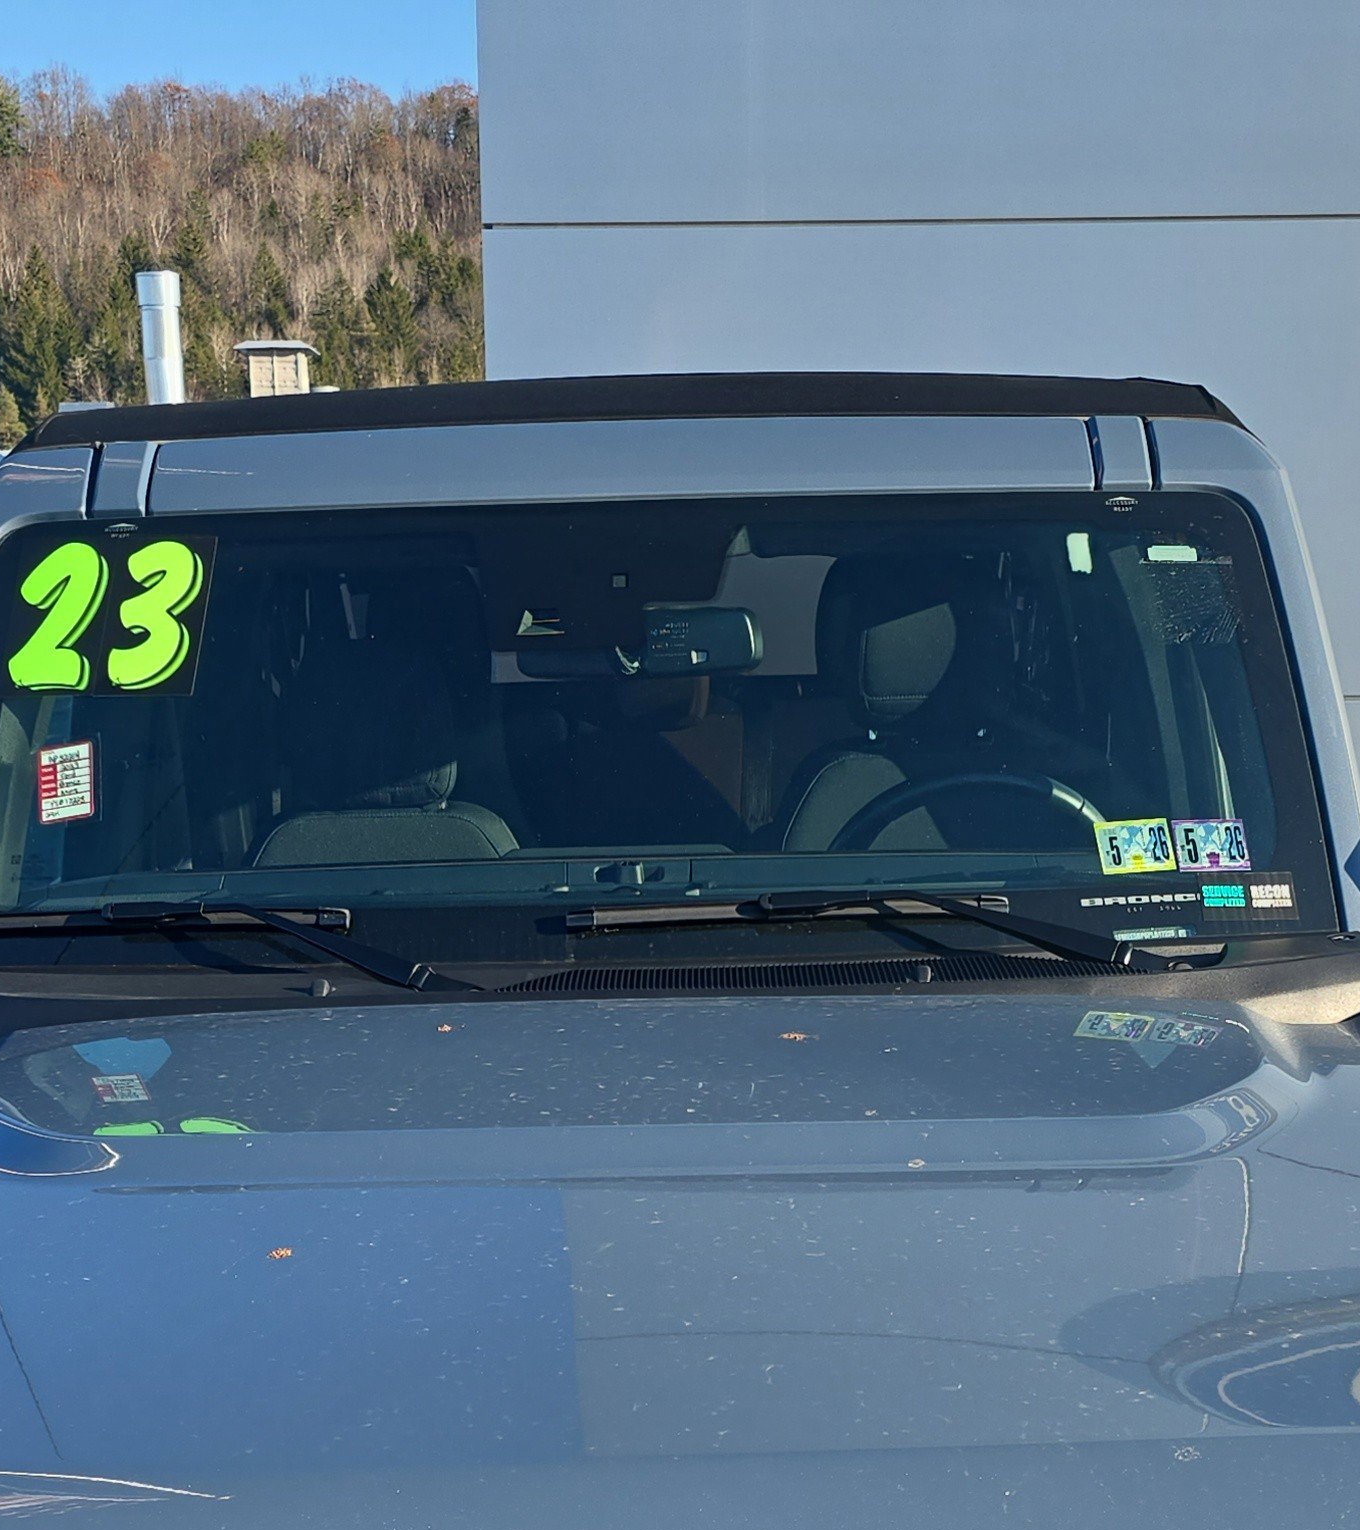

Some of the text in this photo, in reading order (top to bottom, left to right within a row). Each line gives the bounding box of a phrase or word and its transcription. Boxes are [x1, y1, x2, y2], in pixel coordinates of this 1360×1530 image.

[8, 541, 204, 691] 23
[1108, 826, 1170, 866] 5 26
[1183, 825, 1246, 864] 5 26
[1202, 885, 1245, 898] SERVICE
[1250, 884, 1291, 898] RECON
